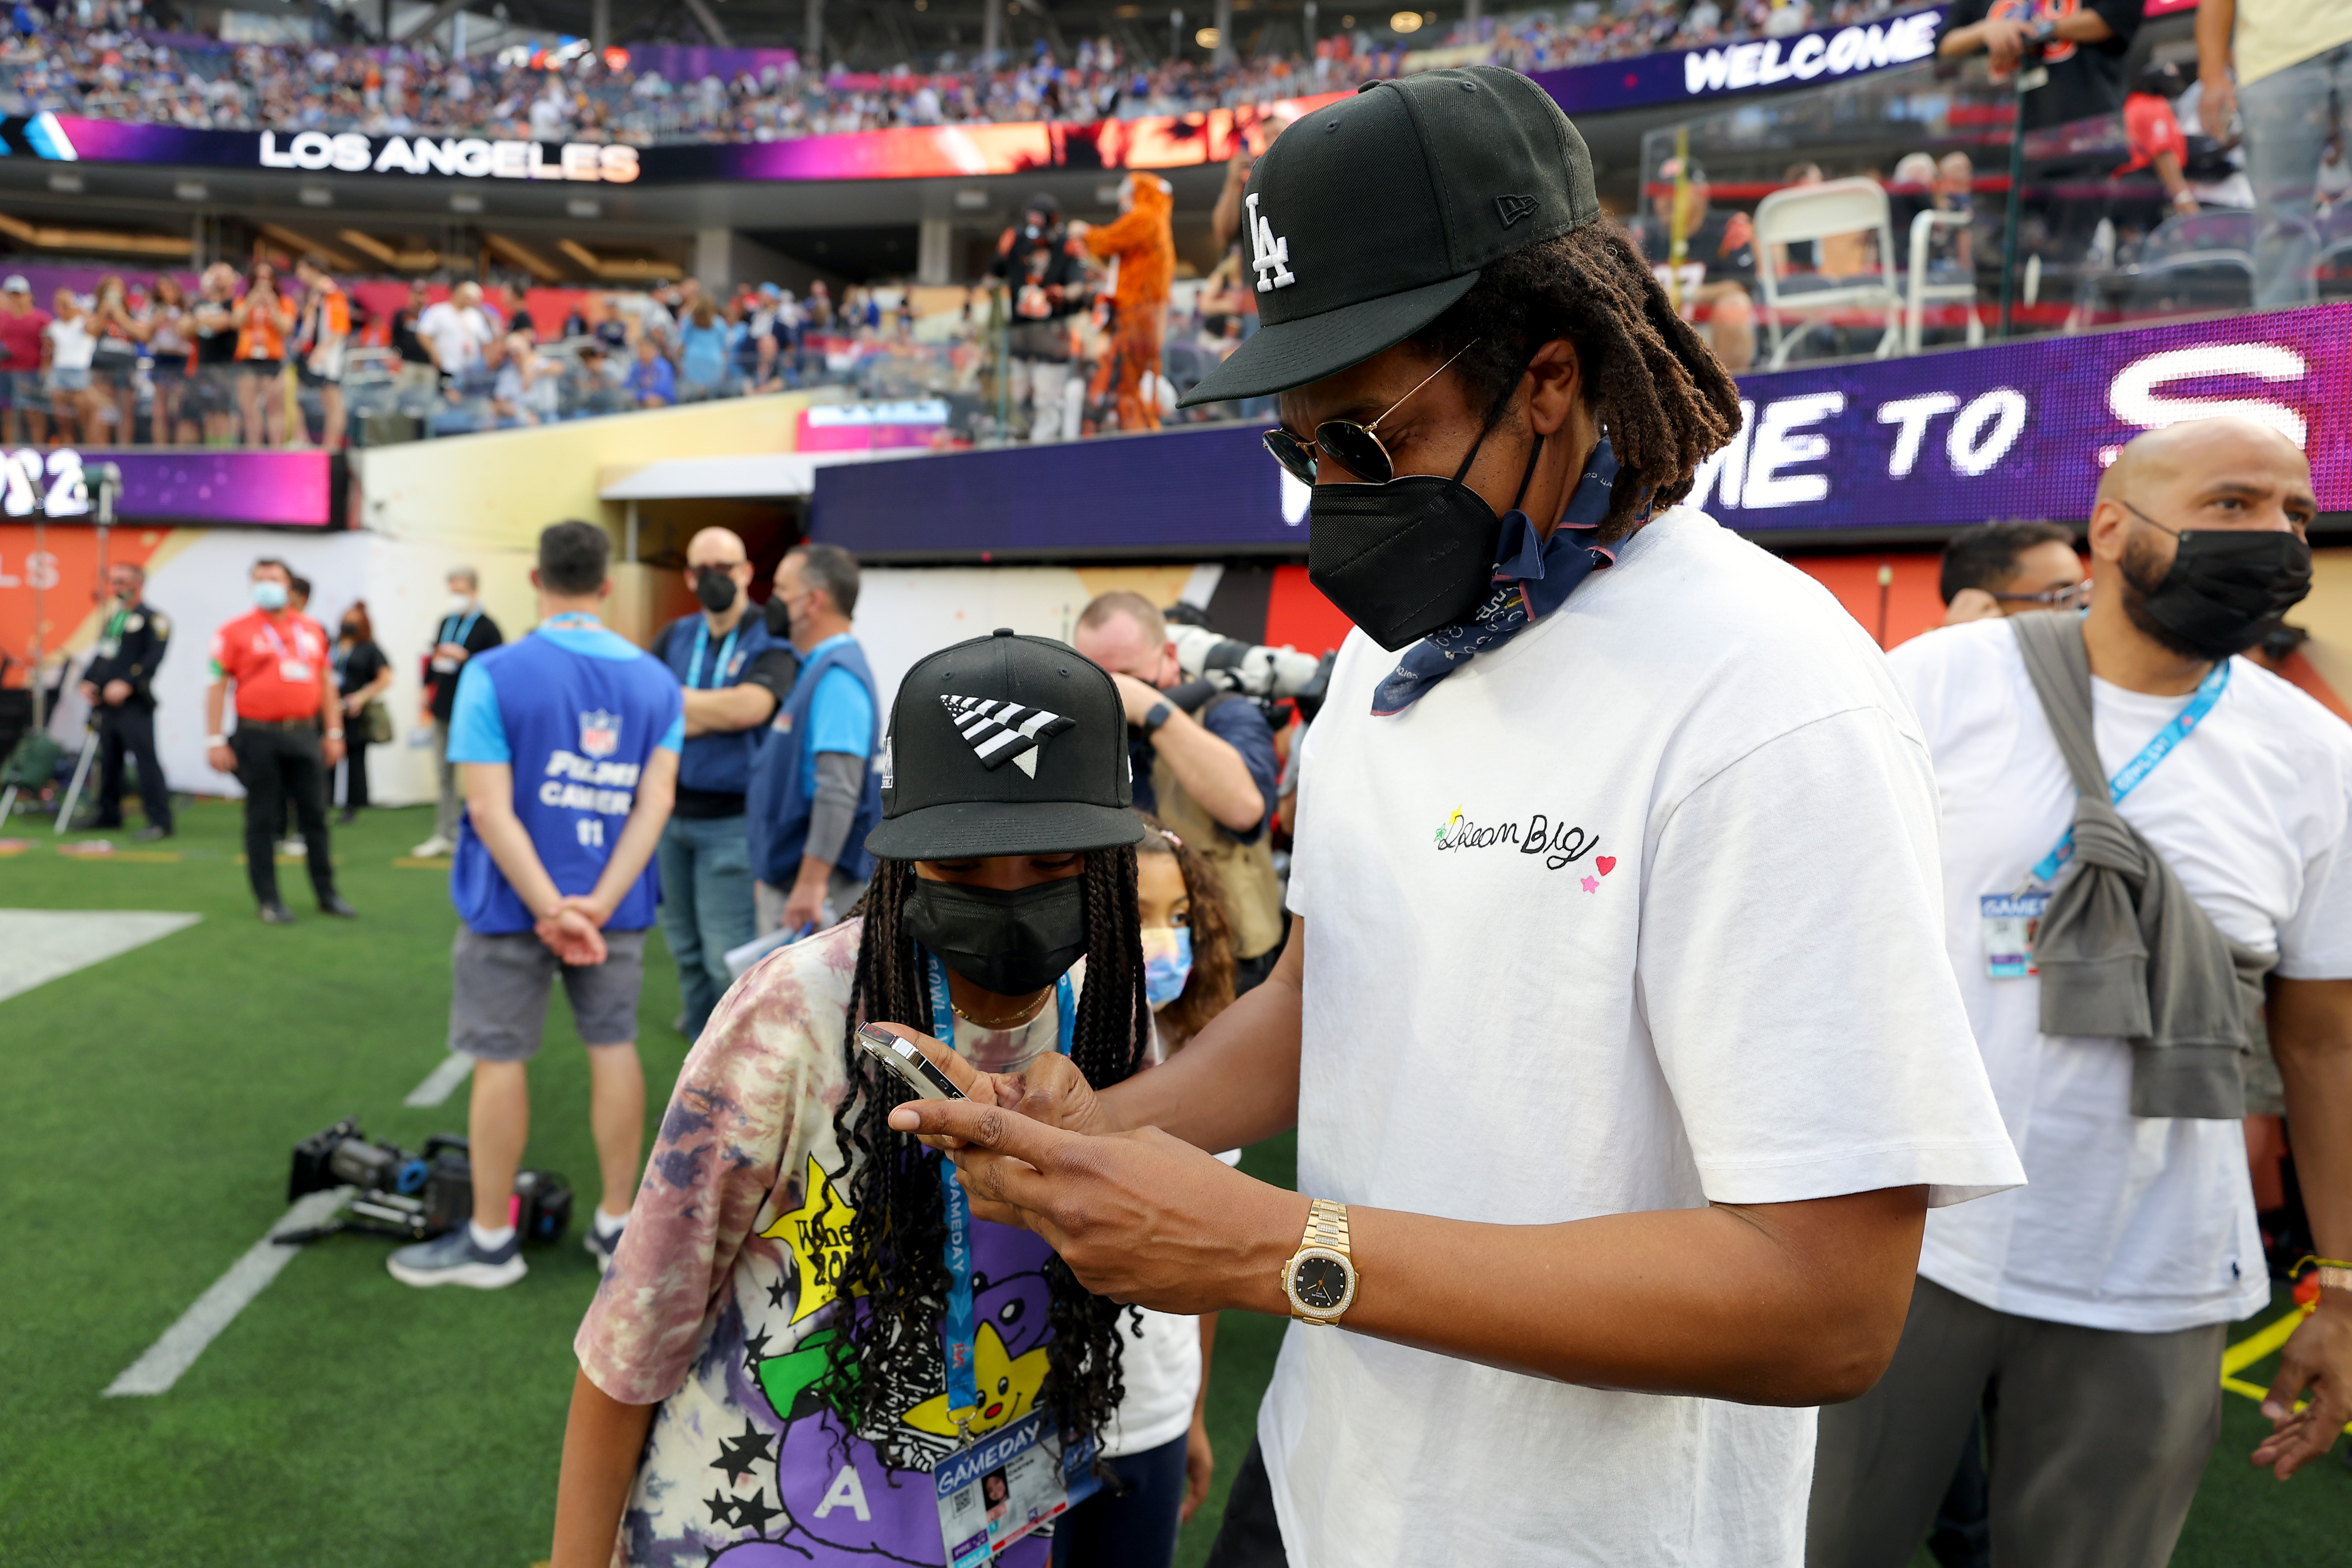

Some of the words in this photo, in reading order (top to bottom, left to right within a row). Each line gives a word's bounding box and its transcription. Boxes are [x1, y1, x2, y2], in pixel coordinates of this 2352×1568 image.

[1684, 10, 1942, 94] WELCOME
[259, 129, 372, 172] LOS
[373, 135, 640, 183] ANGELES
[1246, 192, 1295, 293] LA
[1876, 386, 2027, 479] TO
[1438, 815, 1519, 853] Dream
[928, 959, 945, 1017] BOWL
[948, 1170, 965, 1272] GAMEDAY
[813, 1465, 872, 1522] A
[938, 1420, 1041, 1494] GAMEDAY
